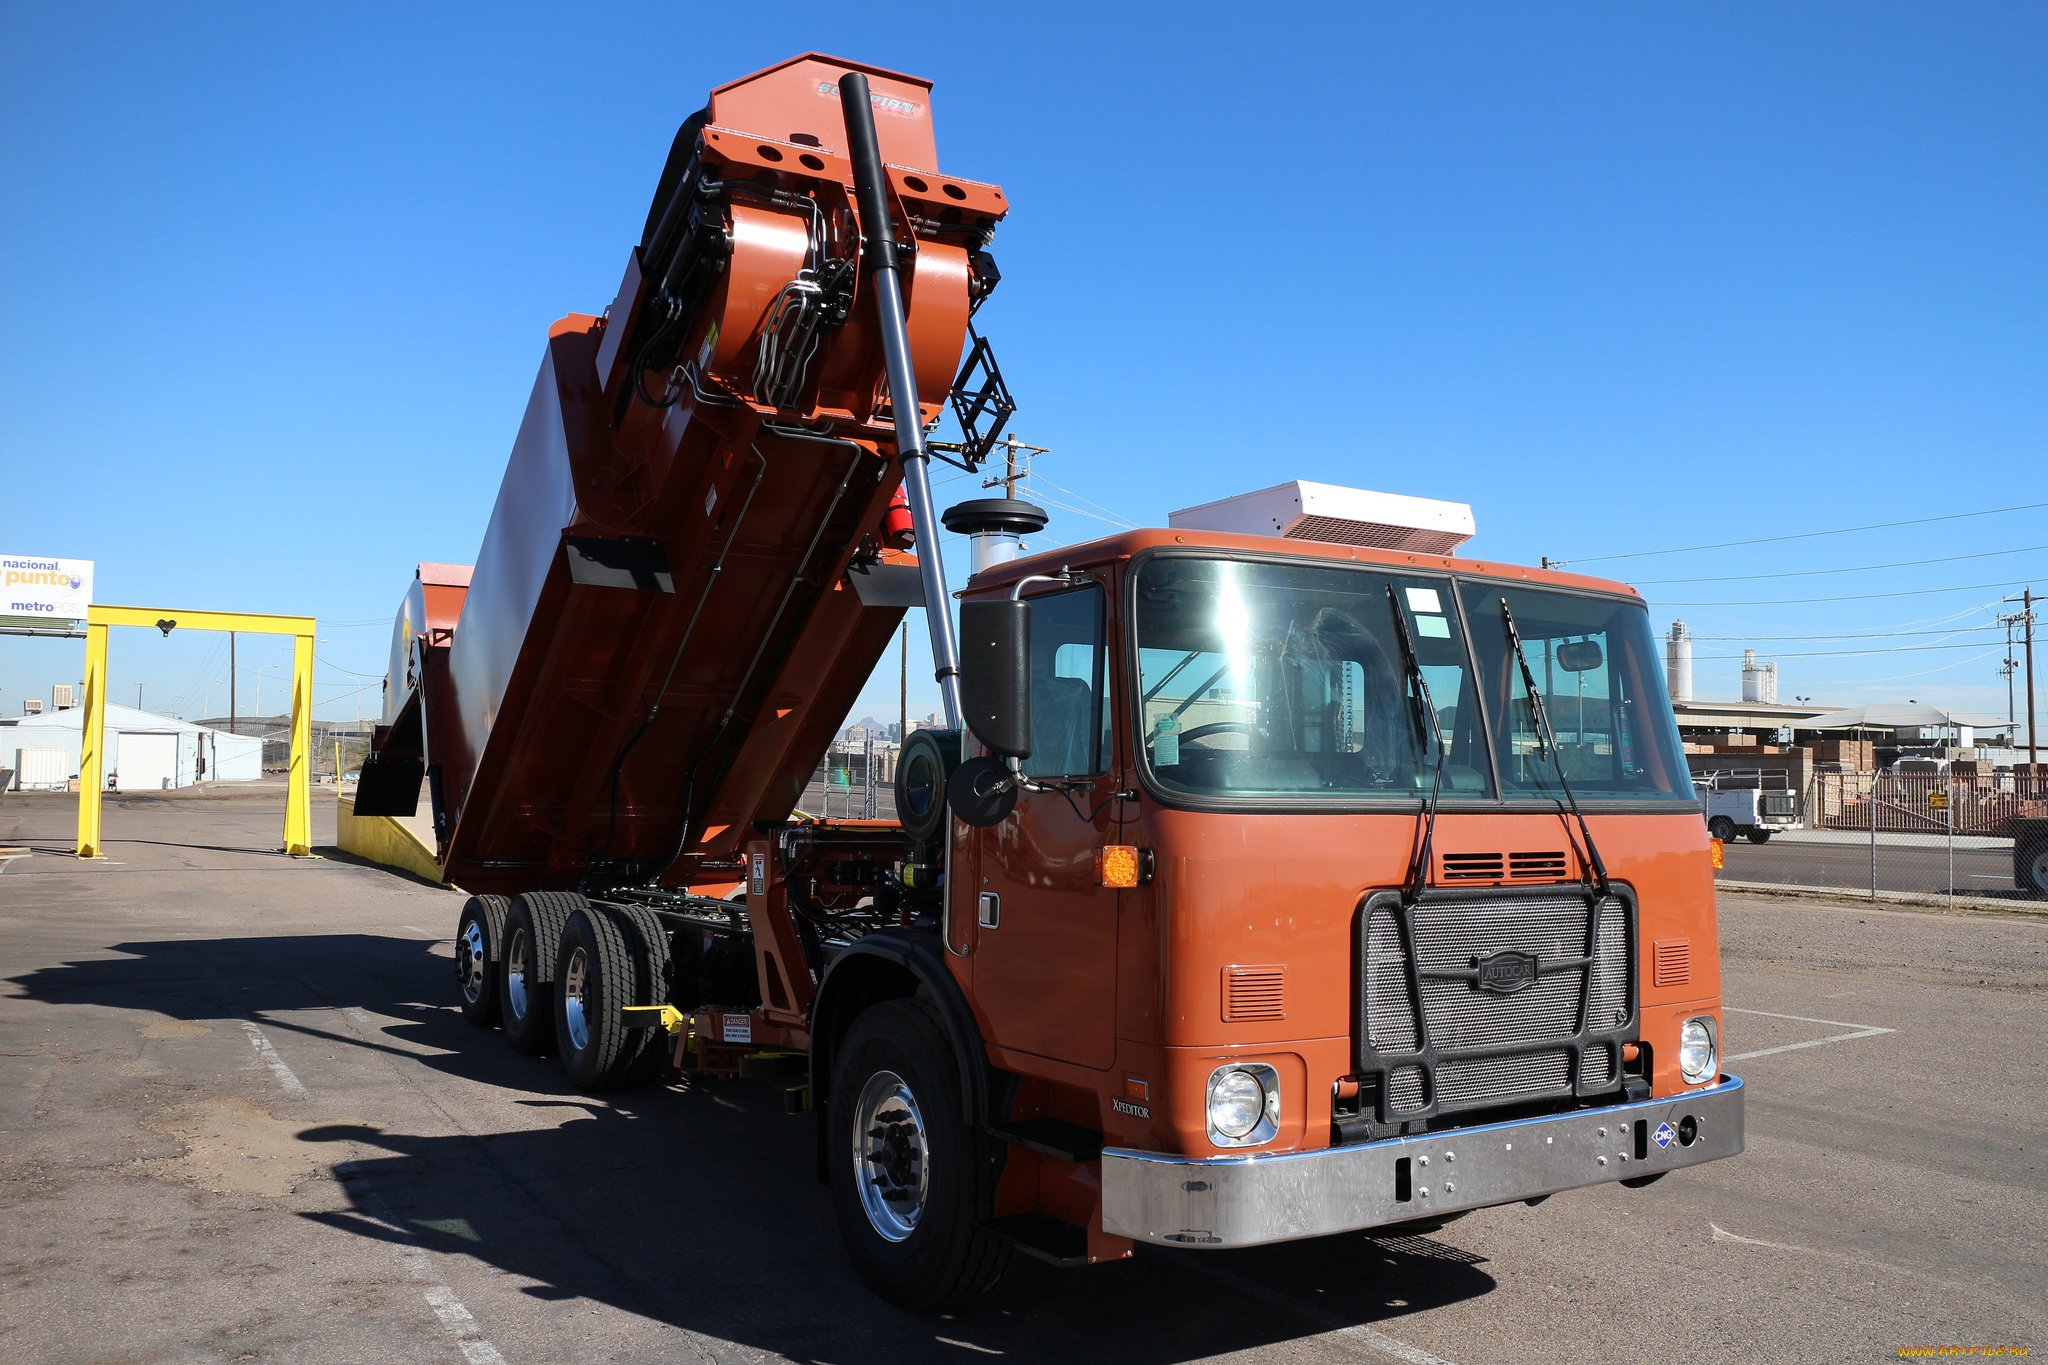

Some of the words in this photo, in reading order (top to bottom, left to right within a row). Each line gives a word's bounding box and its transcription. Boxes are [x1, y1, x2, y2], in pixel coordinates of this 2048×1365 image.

[817, 82, 915, 113] SCPION
[3, 560, 61, 571] nacional.
[5, 570, 71, 587] punto
[1484, 964, 1531, 980] AUTOCAR
[1112, 1098, 1150, 1119] XPEDITOR
[1655, 1130, 1672, 1141] CNG
